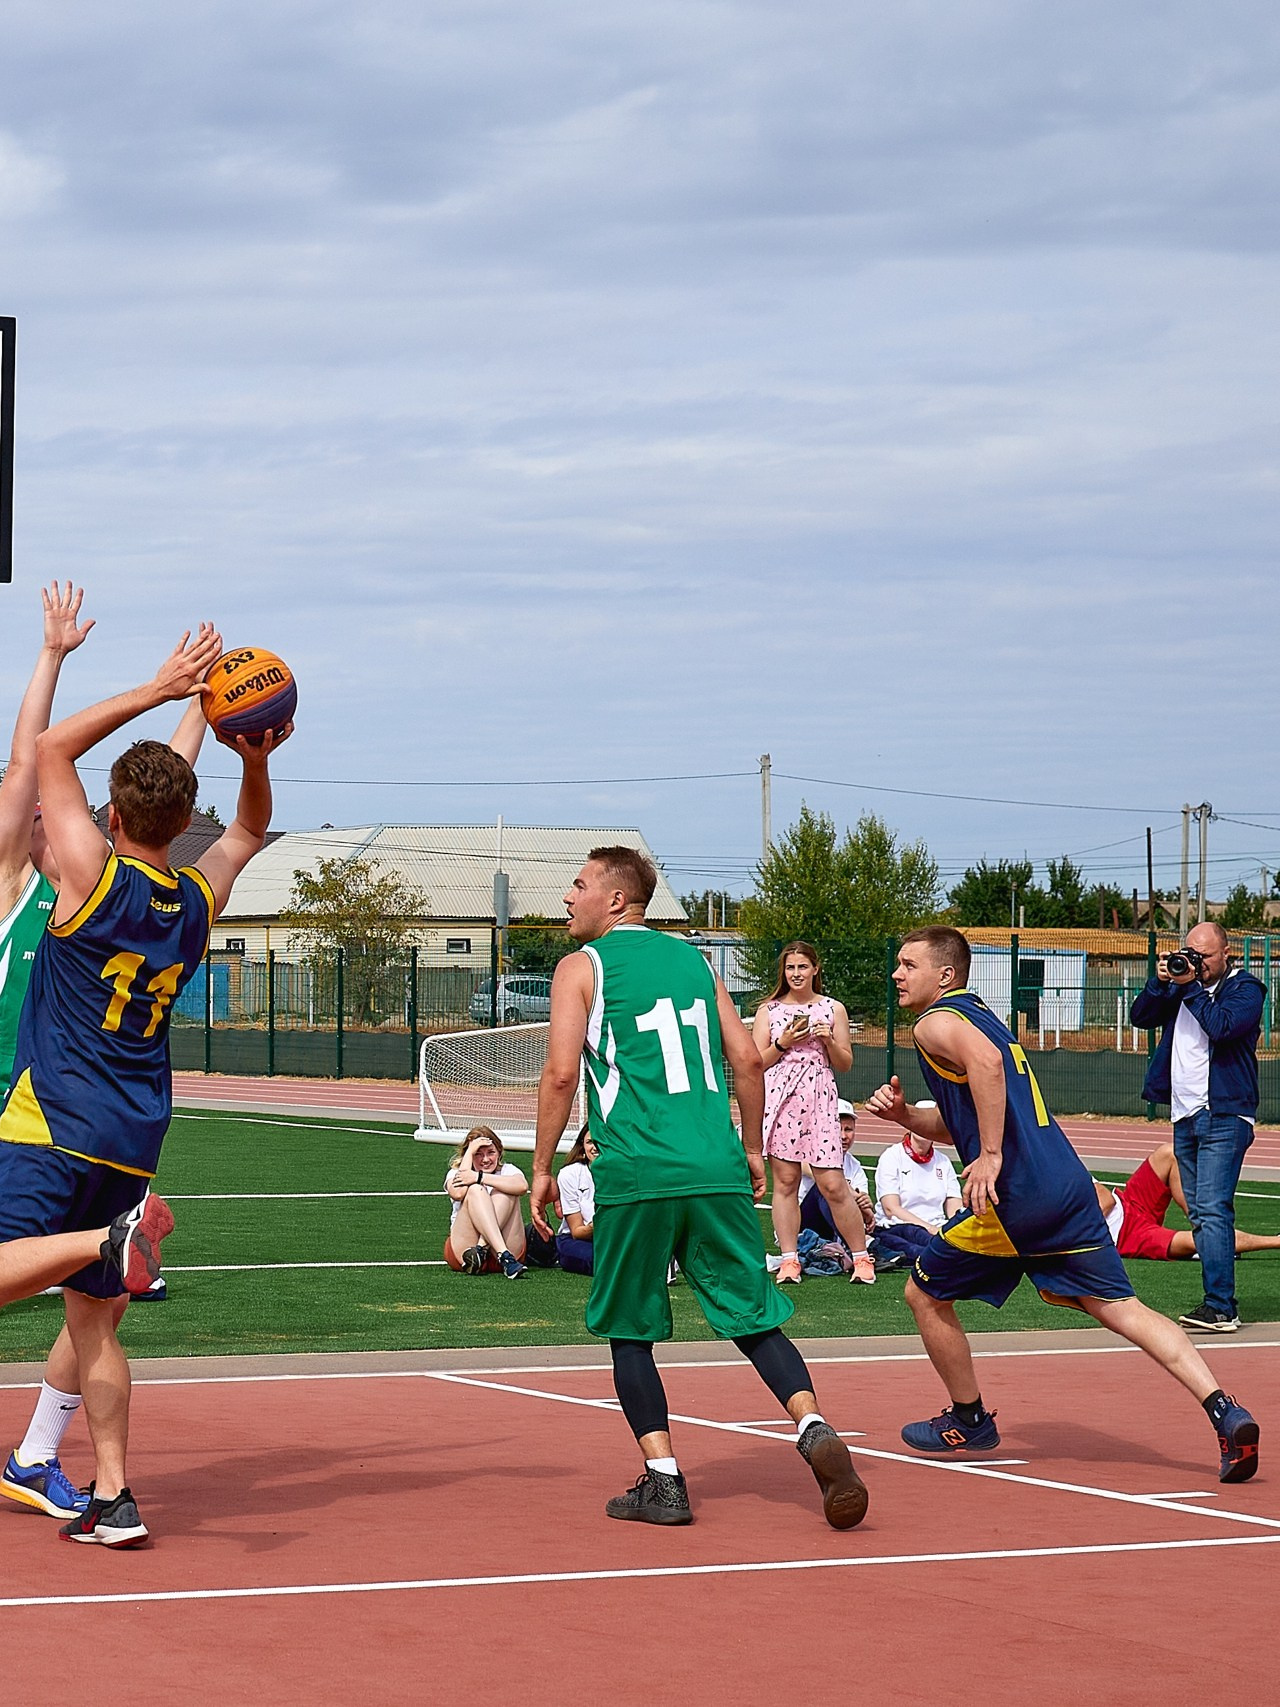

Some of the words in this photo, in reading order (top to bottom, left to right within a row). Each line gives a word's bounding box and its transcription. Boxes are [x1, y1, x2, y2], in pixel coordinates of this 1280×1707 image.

[223, 666, 286, 704] Wilson
[100, 951, 184, 1038] 11
[634, 997, 720, 1095] 11
[1008, 1042, 1050, 1127] 7
